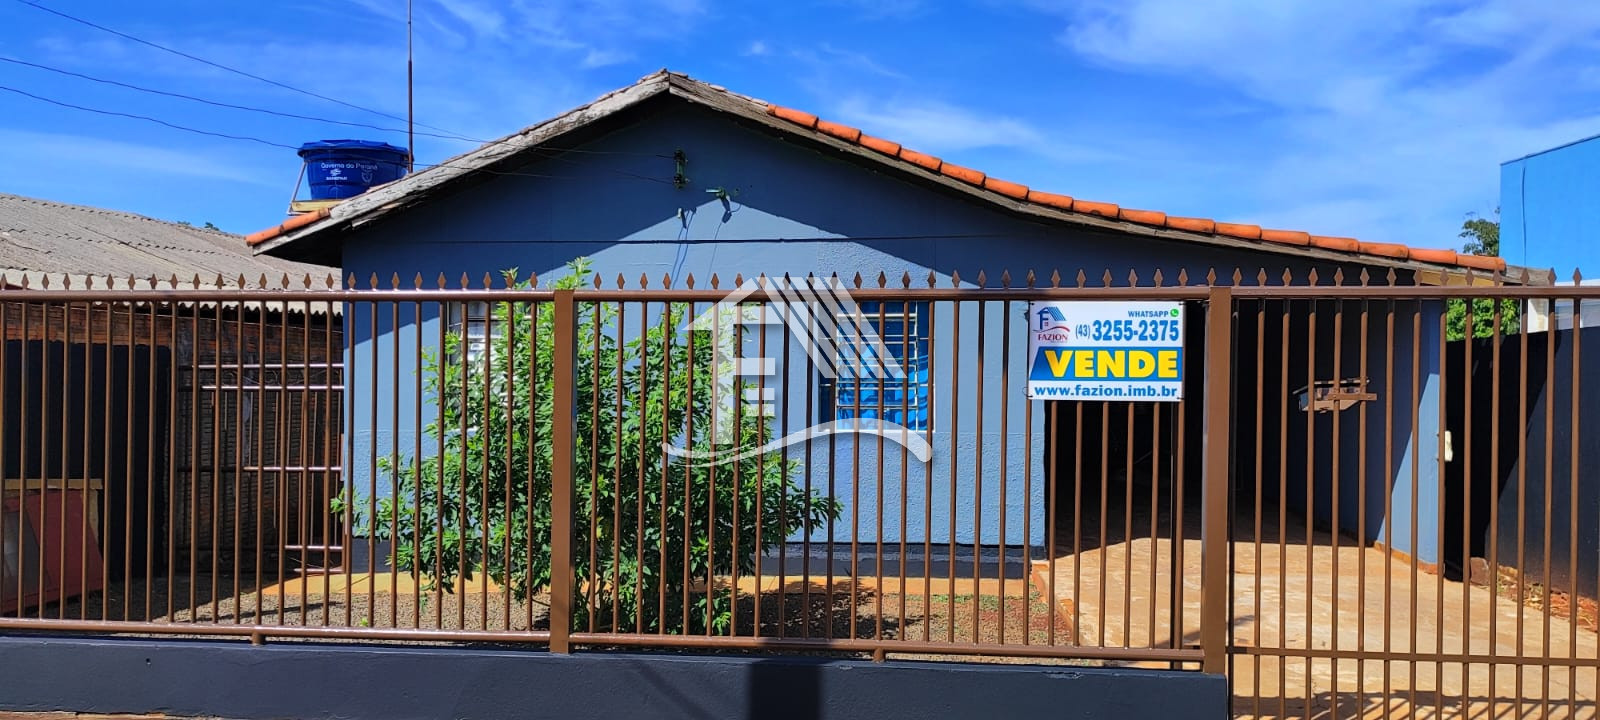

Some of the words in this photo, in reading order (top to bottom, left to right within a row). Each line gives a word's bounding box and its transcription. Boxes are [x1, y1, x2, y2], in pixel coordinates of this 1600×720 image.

[1038, 332, 1068, 341] FAZION
[1075, 324, 1091, 340] (43)
[1092, 320, 1180, 341] 3255-2375
[1045, 350, 1178, 378] VENDE
[1034, 384, 1178, 397] www.fazion.imb.br
